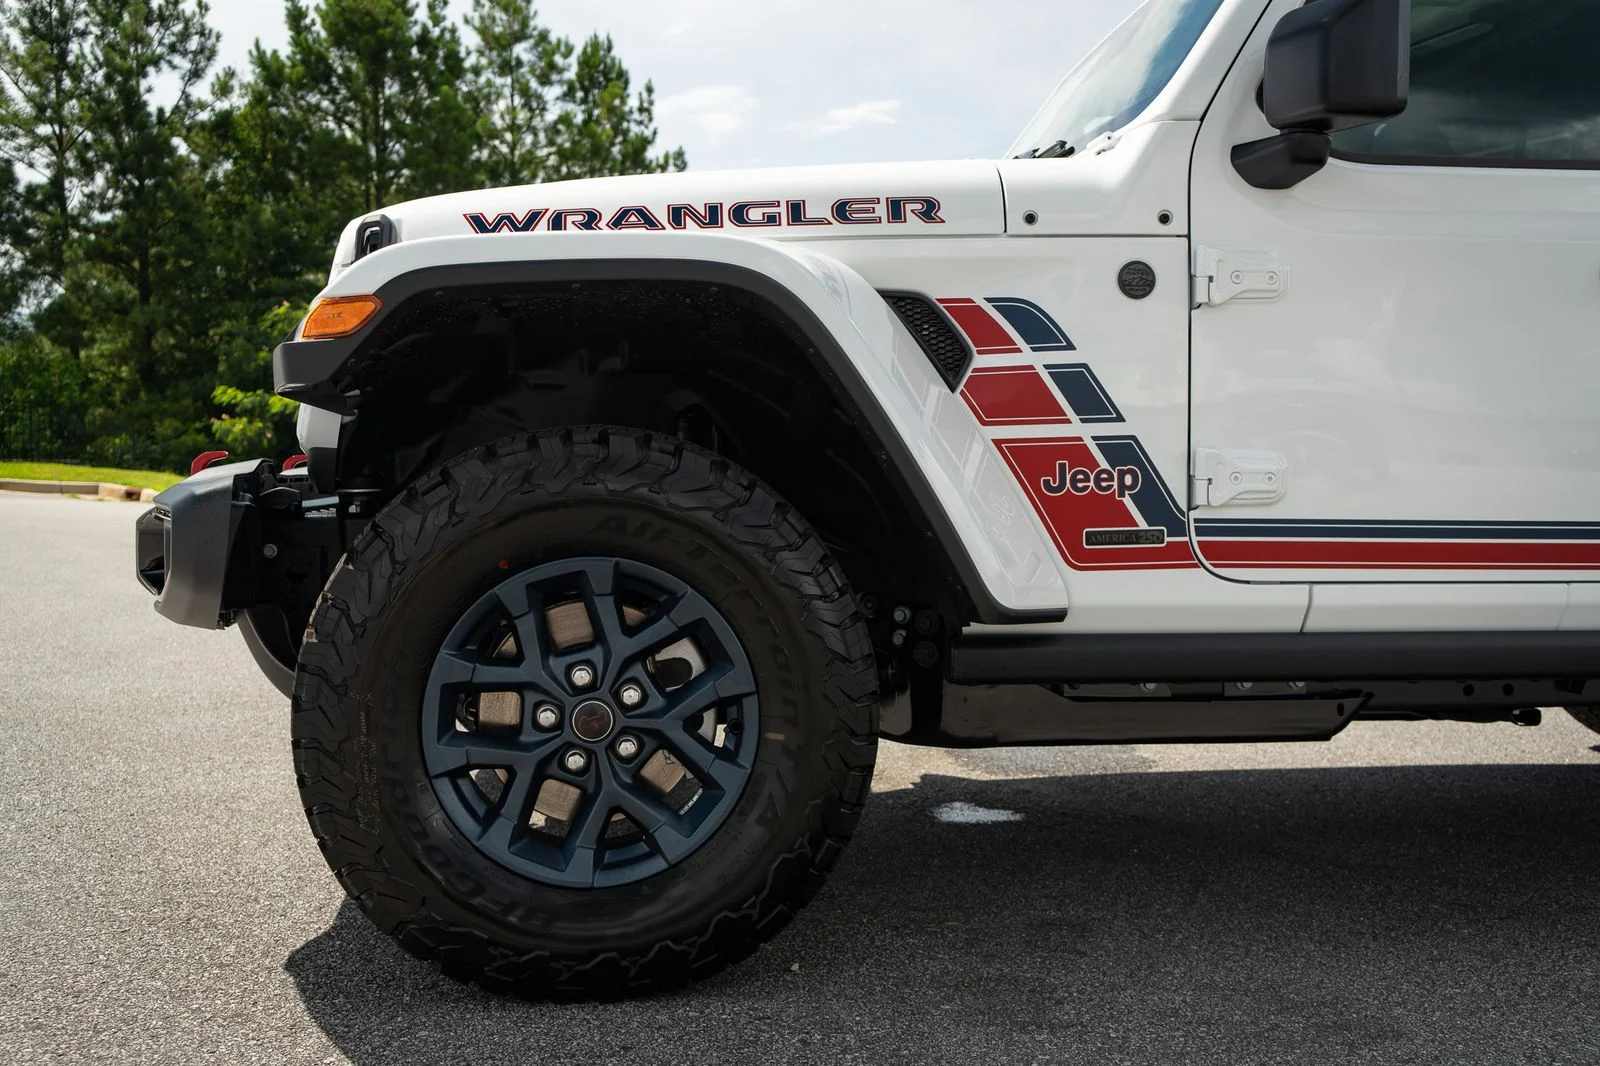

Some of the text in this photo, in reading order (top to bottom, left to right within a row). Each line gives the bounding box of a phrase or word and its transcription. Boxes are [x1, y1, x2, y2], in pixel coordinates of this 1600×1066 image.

[463, 196, 945, 233] WRANGLER
[1041, 460, 1142, 500] Jeep
[1089, 530, 1163, 544] AMERICA 250
